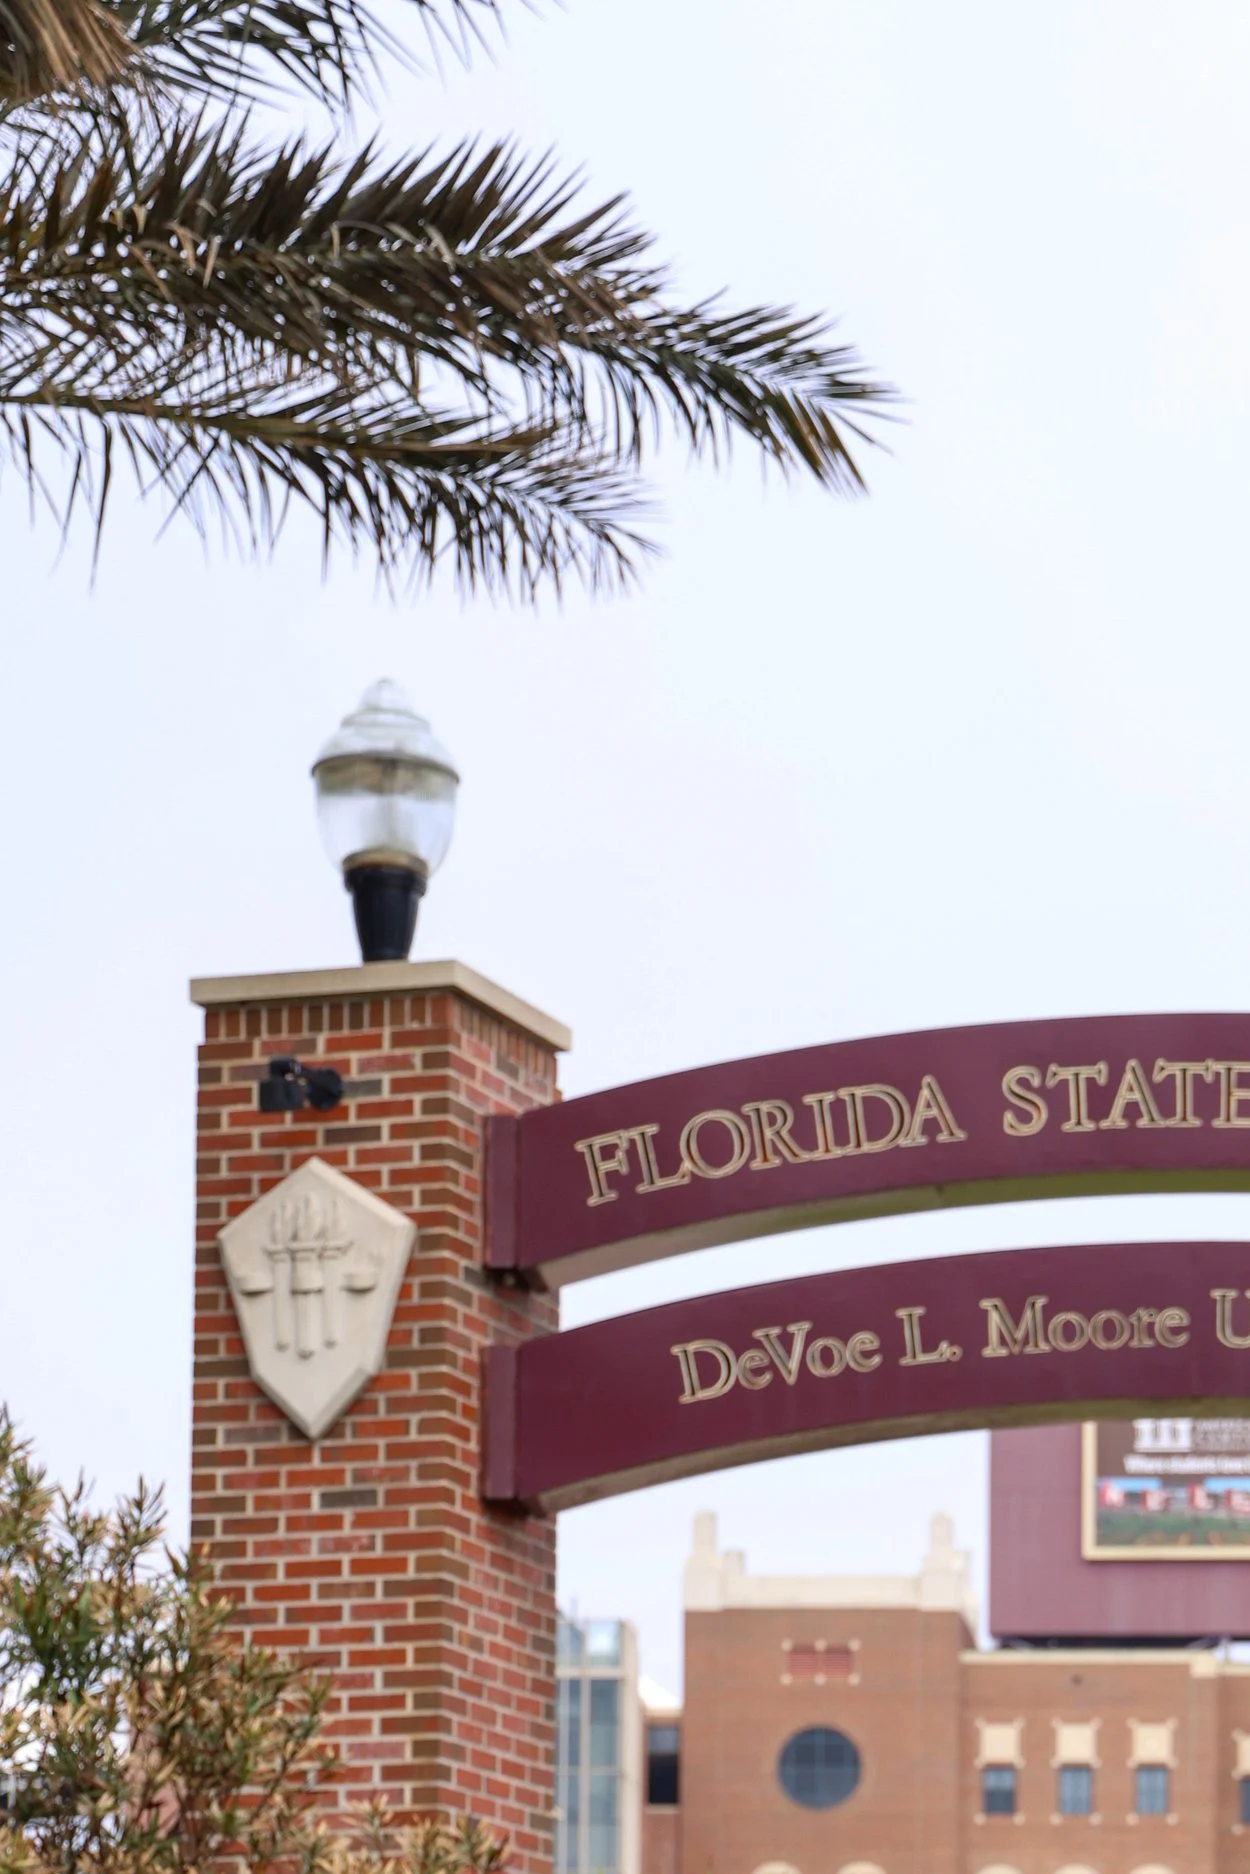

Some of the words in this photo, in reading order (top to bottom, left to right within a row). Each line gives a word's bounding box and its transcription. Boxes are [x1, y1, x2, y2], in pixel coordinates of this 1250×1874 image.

[574, 1075, 968, 1207] FLORIDA
[671, 1321, 882, 1405] DeVoe
[896, 1306, 962, 1367] L.
[979, 1297, 1191, 1358] Moore
